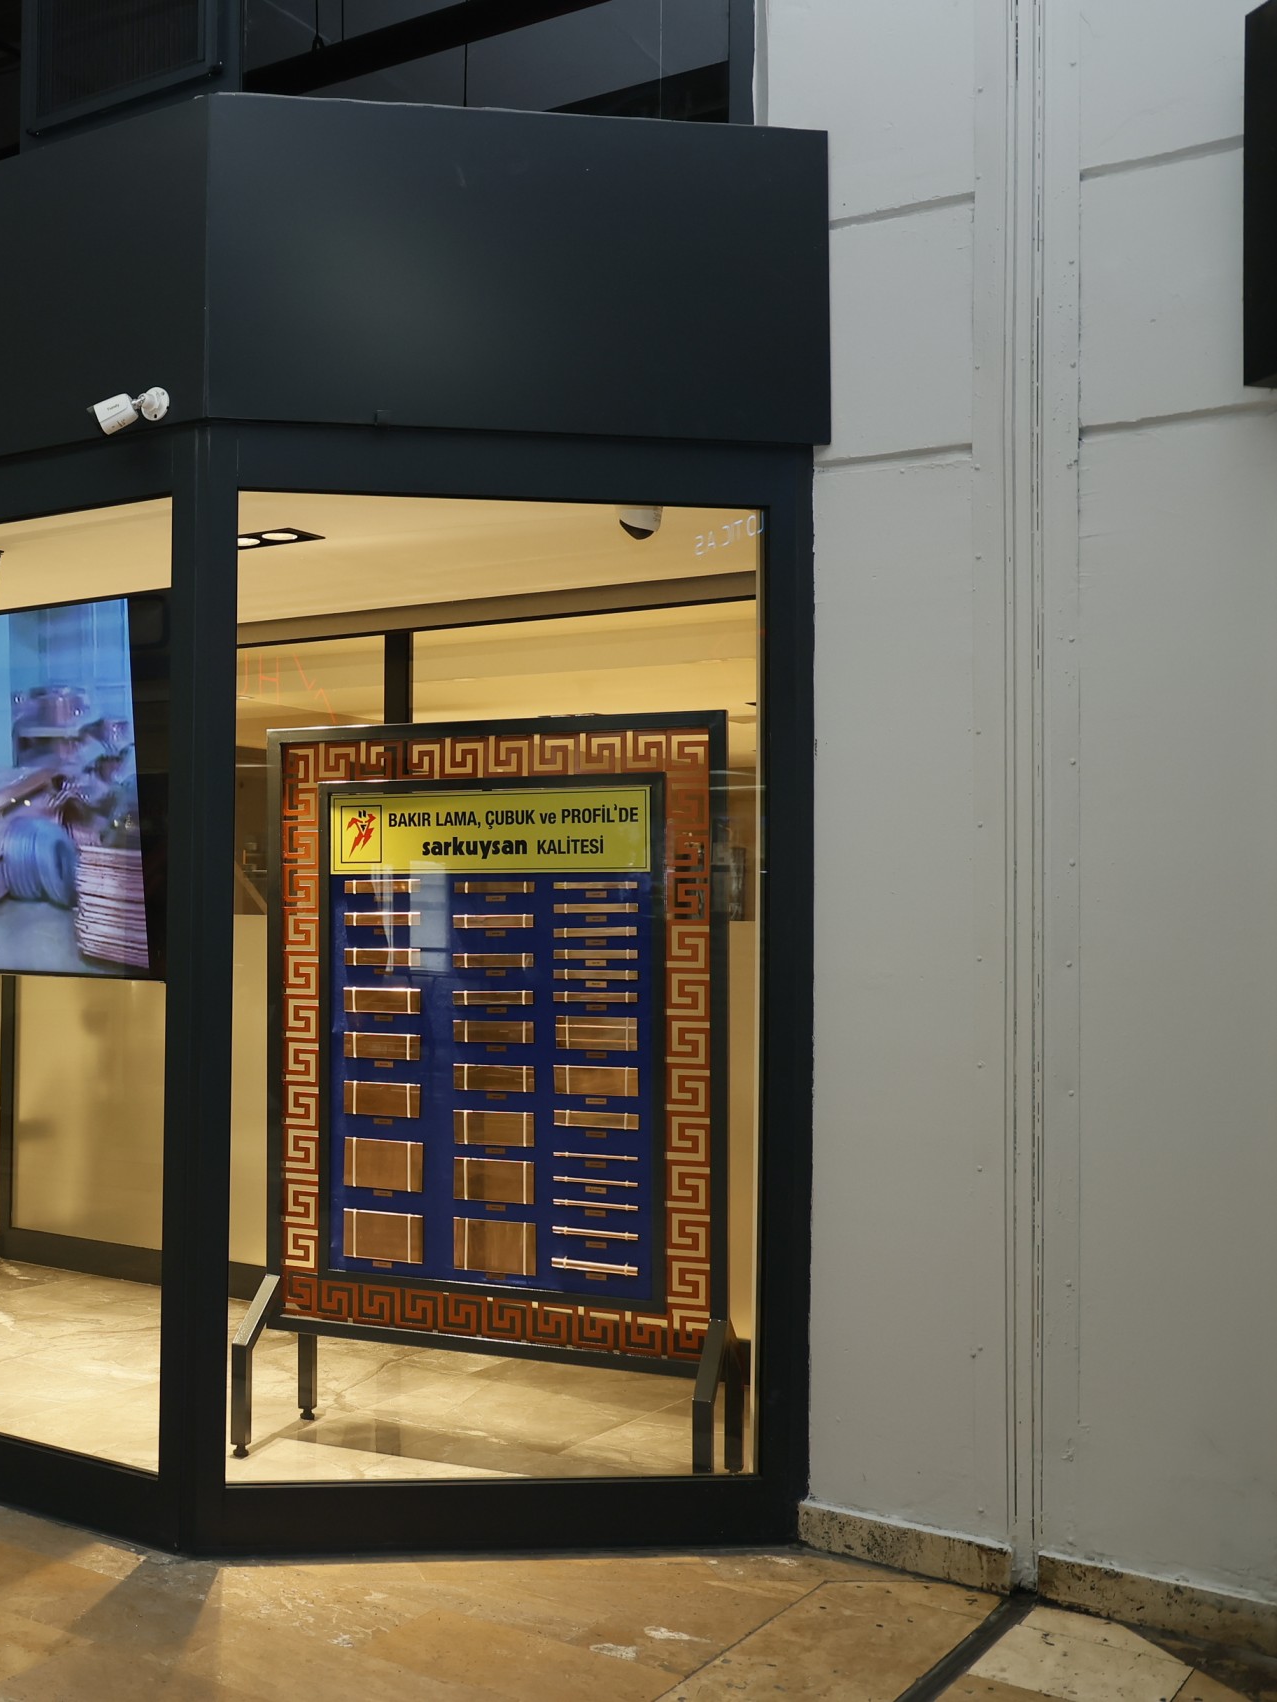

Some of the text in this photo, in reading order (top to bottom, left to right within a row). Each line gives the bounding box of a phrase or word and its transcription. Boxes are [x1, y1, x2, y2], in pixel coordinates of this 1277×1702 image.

[388, 803, 639, 830] BAKIR LAMA, ÇUBUK ve PROFİL'DE
[422, 835, 604, 860] sarkuysan KALİTESİ
